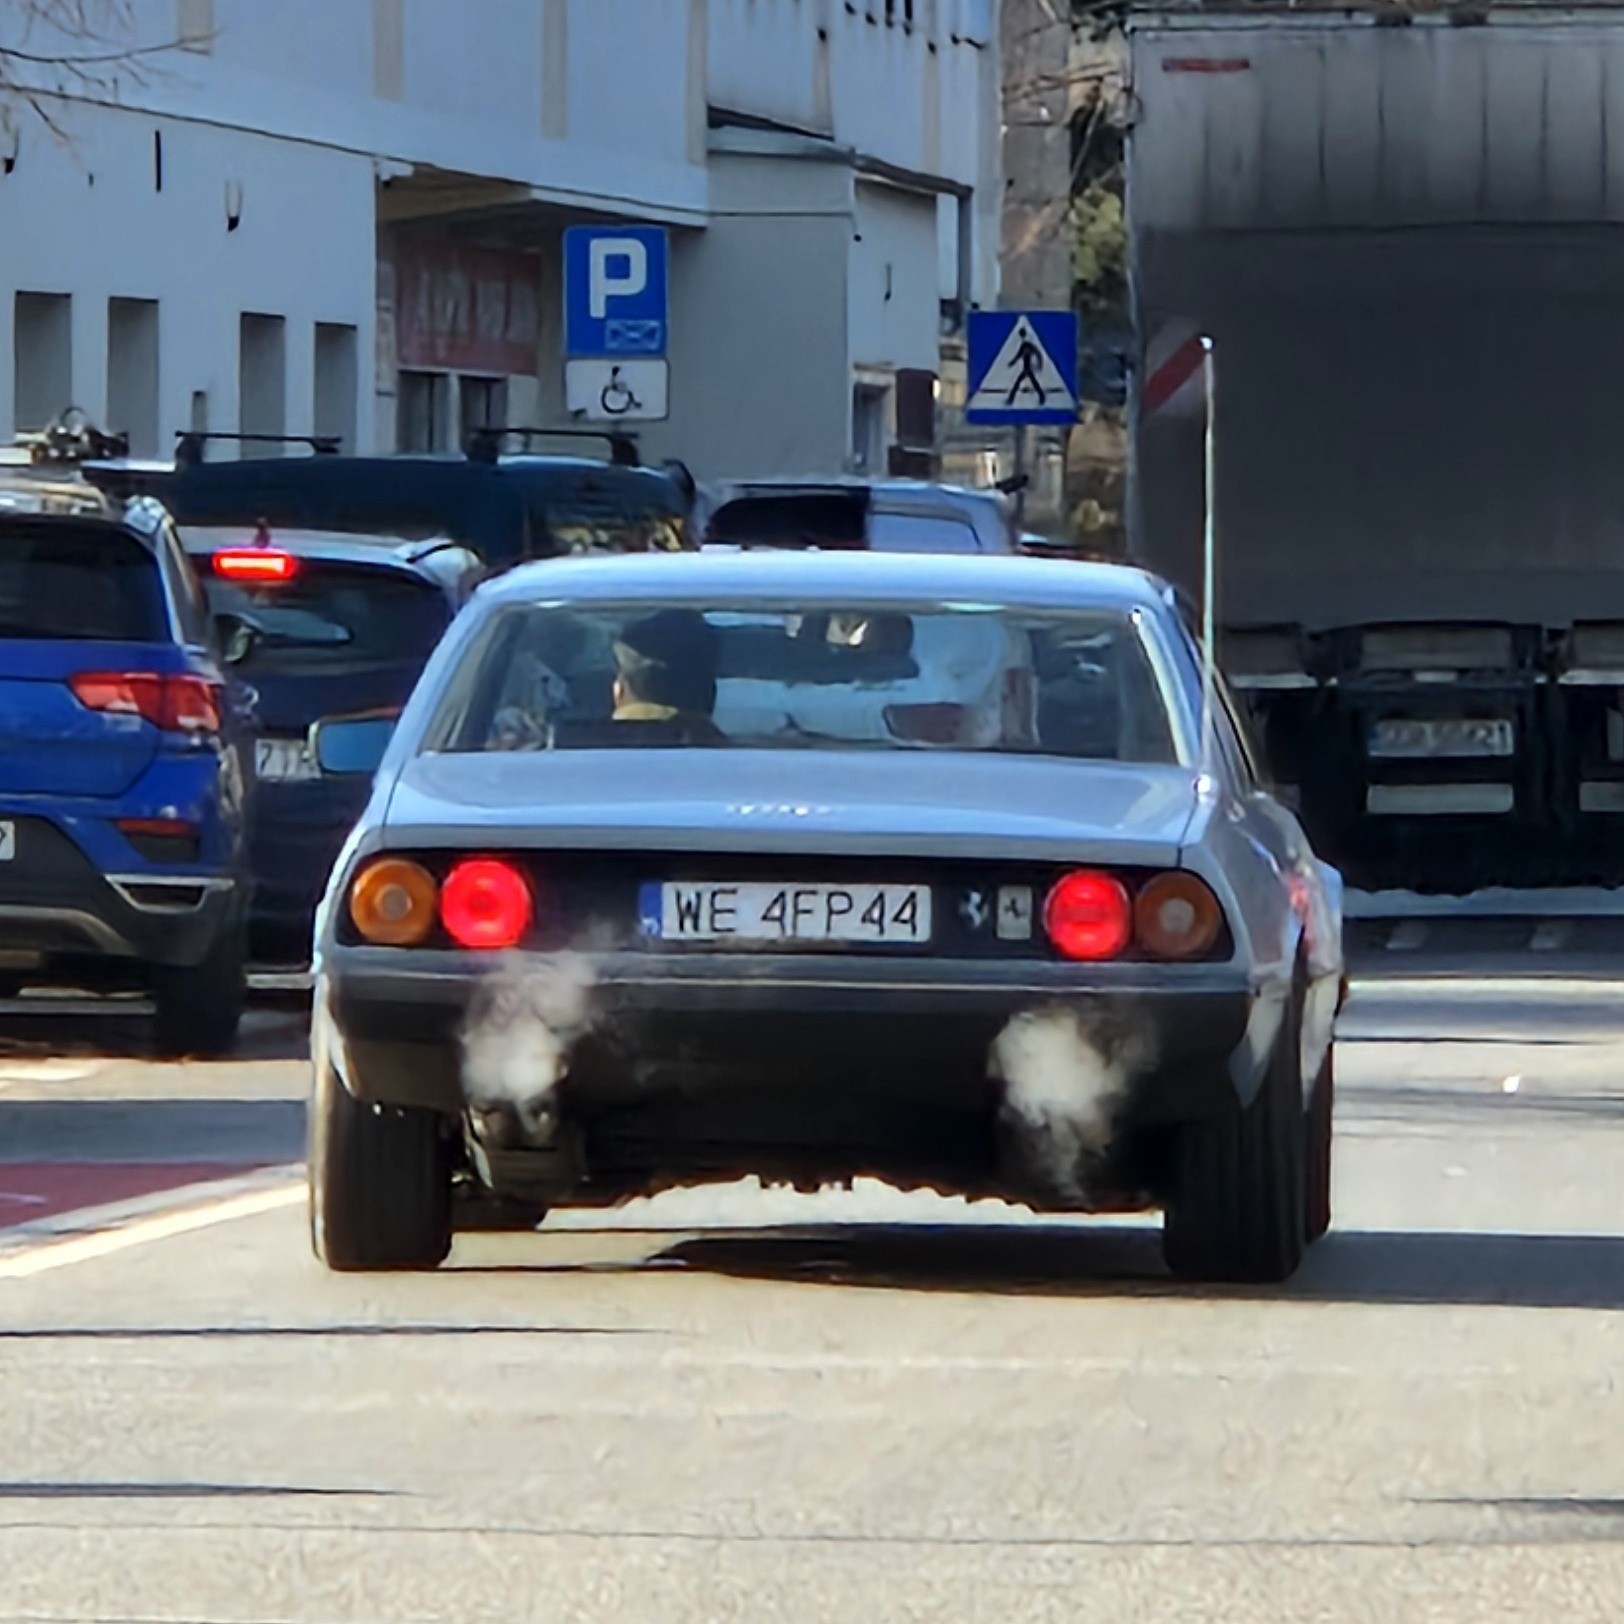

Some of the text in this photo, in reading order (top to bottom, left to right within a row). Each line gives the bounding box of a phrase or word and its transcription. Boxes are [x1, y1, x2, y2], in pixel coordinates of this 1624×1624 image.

[590, 239, 647, 319] P
[674, 888, 738, 933] WE
[761, 889, 918, 936] 4FP44
